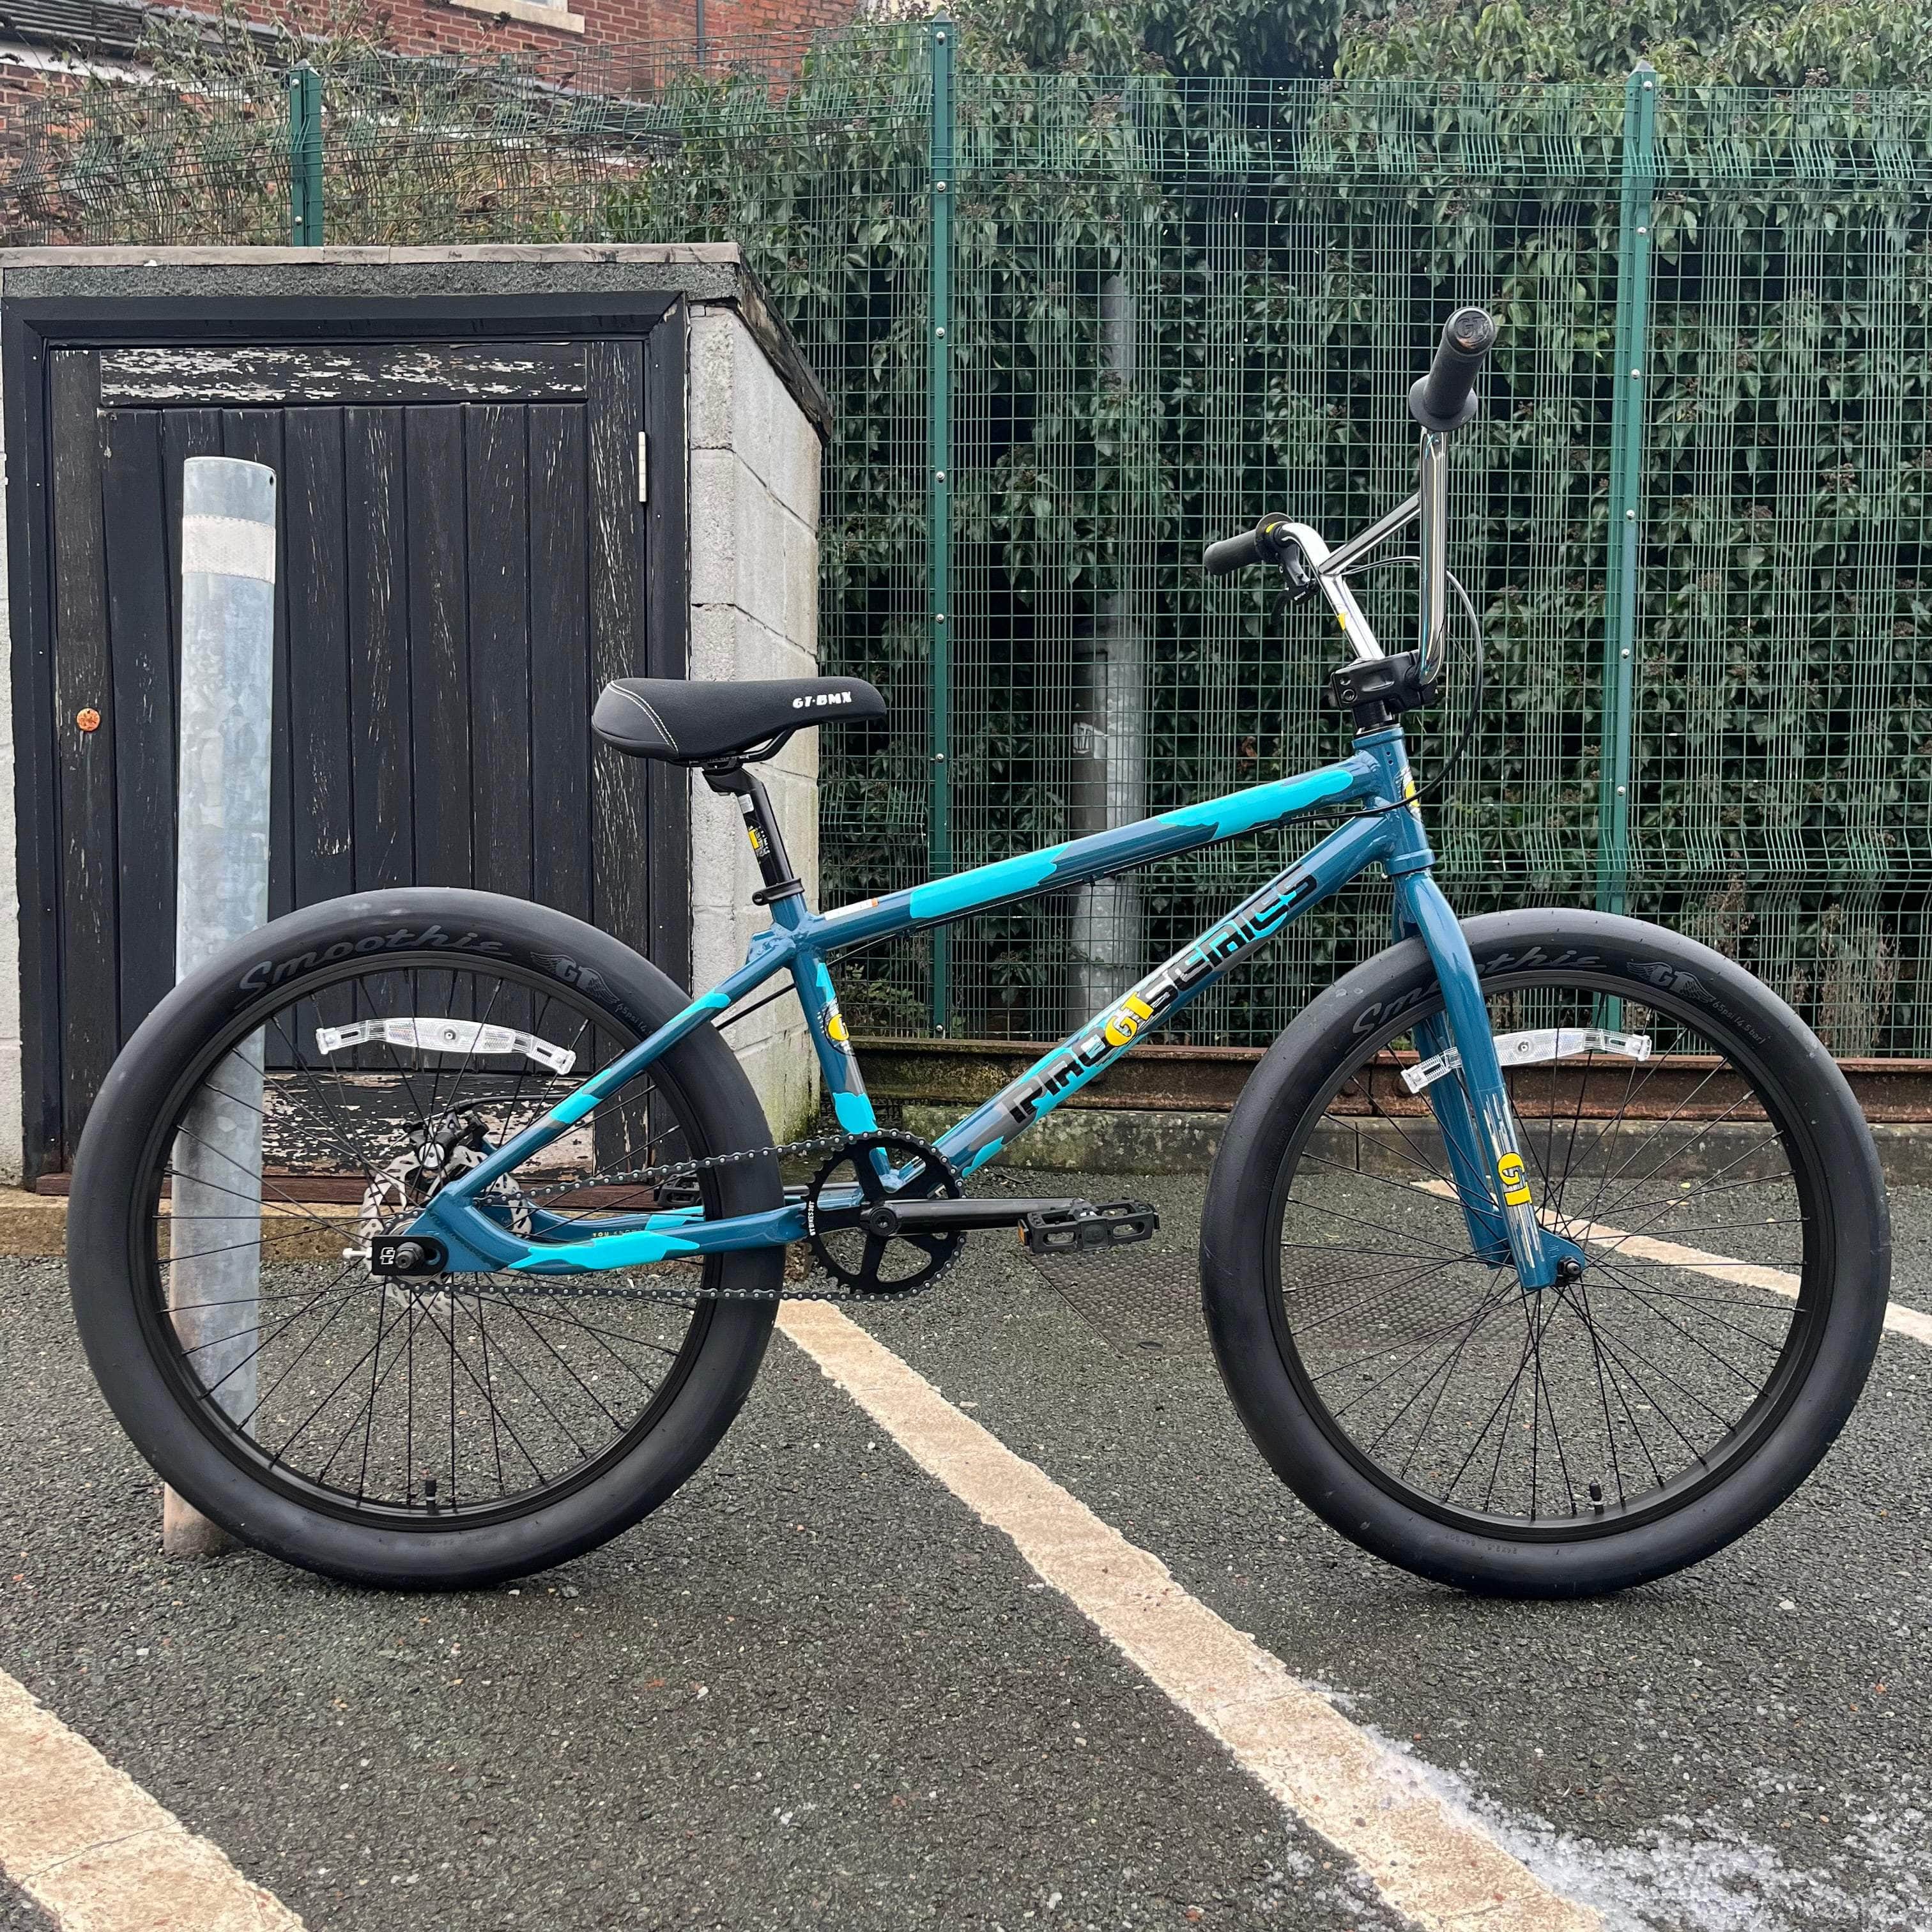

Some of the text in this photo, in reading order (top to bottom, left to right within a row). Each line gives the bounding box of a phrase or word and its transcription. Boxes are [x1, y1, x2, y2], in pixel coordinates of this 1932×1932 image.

[240, 925, 511, 990] Smoothie
[1002, 1027, 1115, 1123] PRO
[1137, 864, 1317, 1015] SERIES
[1353, 947, 1607, 1034] Smthie
